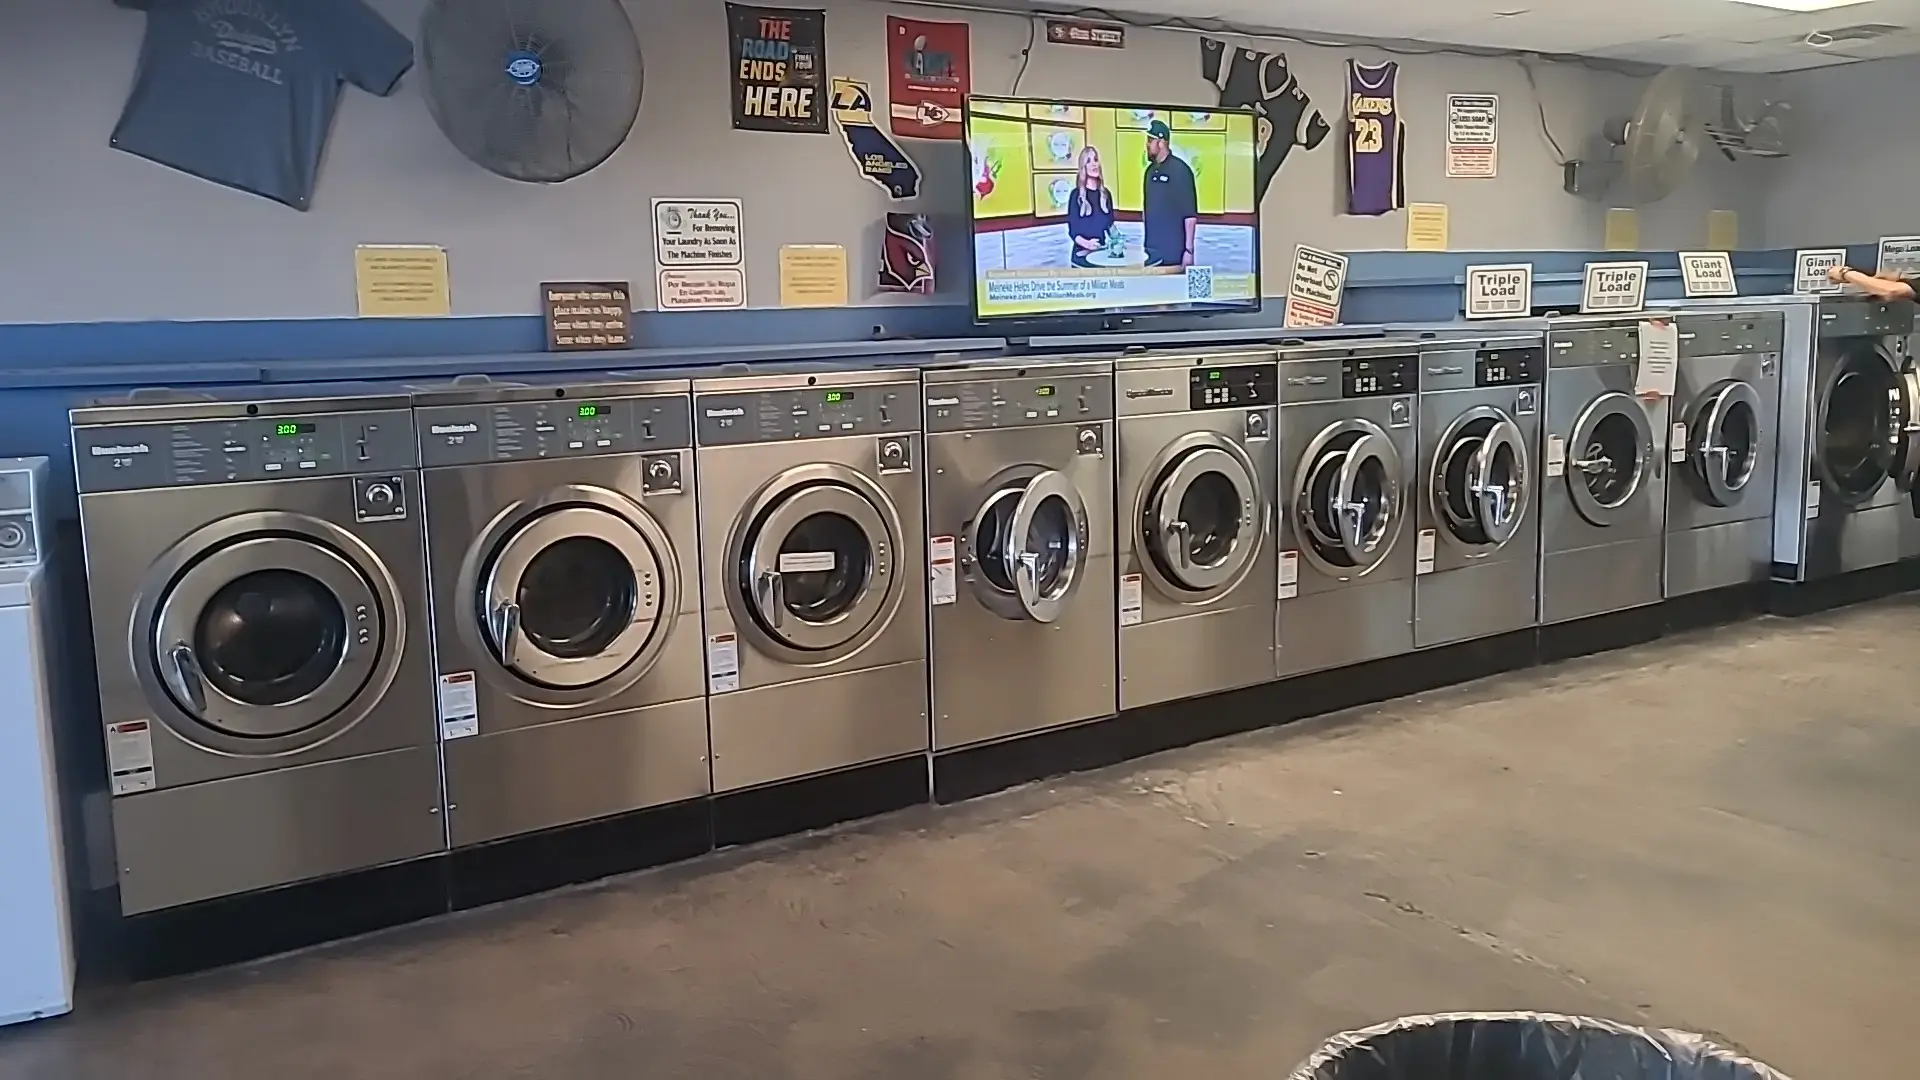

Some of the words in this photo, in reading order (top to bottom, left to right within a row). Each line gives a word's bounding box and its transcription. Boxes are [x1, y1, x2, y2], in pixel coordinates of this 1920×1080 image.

[759, 19, 792, 40] THE
[743, 39, 789, 60] ROAD
[189, 40, 283, 85] BASEBALL
[740, 59, 787, 81] ENDS
[744, 85, 813, 118] HERE
[1355, 119, 1383, 152] 23
[865, 153, 884, 161] LOS
[688, 208, 711, 219] Thank
[705, 224, 736, 233] Removing
[678, 237, 702, 247] Laundry
[704, 237, 712, 245] As
[713, 237, 727, 245] Soon
[729, 237, 736, 245] As
[667, 251, 679, 259] The
[708, 250, 732, 258] Finishes
[1691, 260, 1722, 269] Giant
[1806, 258, 1837, 267] Giant
[1596, 271, 1637, 283] Triple
[1695, 269, 1722, 278] Load
[1807, 267, 1830, 276] Loa
[1296, 273, 1322, 287] Overload
[1477, 273, 1521, 287] Triple
[989, 281, 1013, 292] Meineke
[1294, 284, 1304, 293] The
[1482, 285, 1516, 296] Load
[1599, 282, 1632, 292] Load
